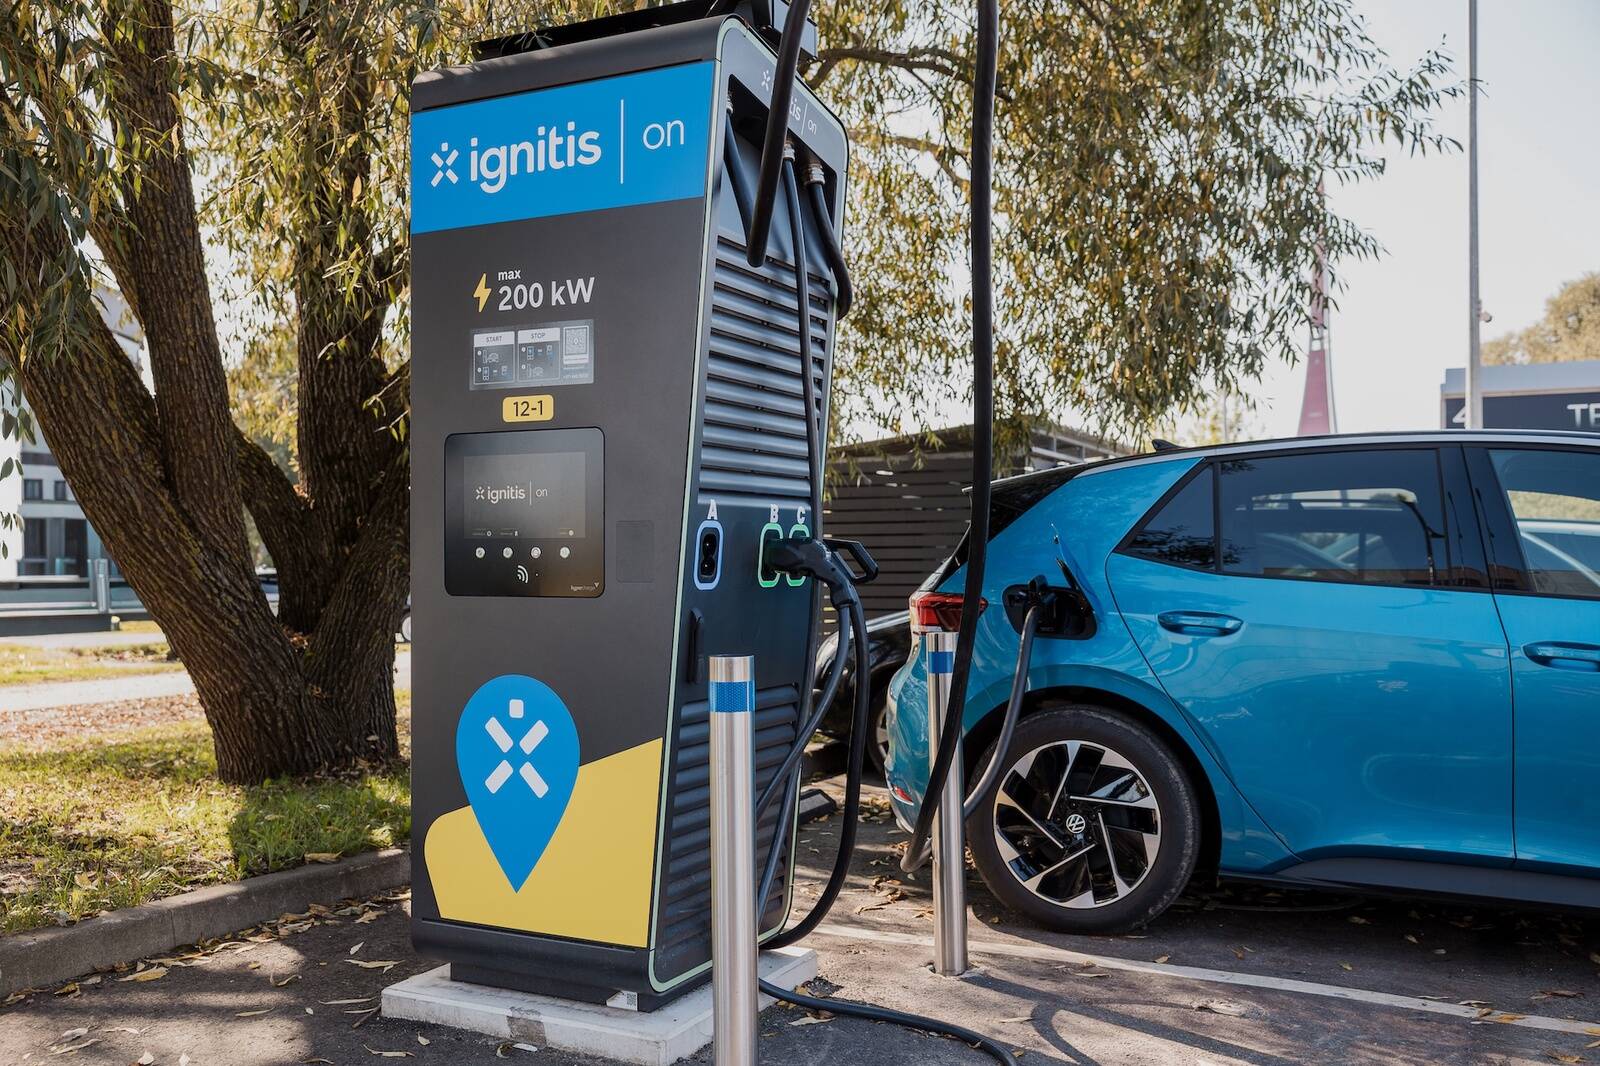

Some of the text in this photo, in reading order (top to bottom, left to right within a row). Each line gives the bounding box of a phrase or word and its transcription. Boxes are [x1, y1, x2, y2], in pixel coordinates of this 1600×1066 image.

[807, 119, 817, 135] on
[470, 119, 685, 194] ignitis on
[498, 269, 521, 281] max
[498, 277, 595, 311] 200 kW
[486, 335, 503, 343] START
[513, 400, 543, 417] 12-1
[487, 485, 548, 504] ignitis on
[706, 499, 718, 520] A
[770, 503, 779, 523] B
[796, 506, 806, 524] C
